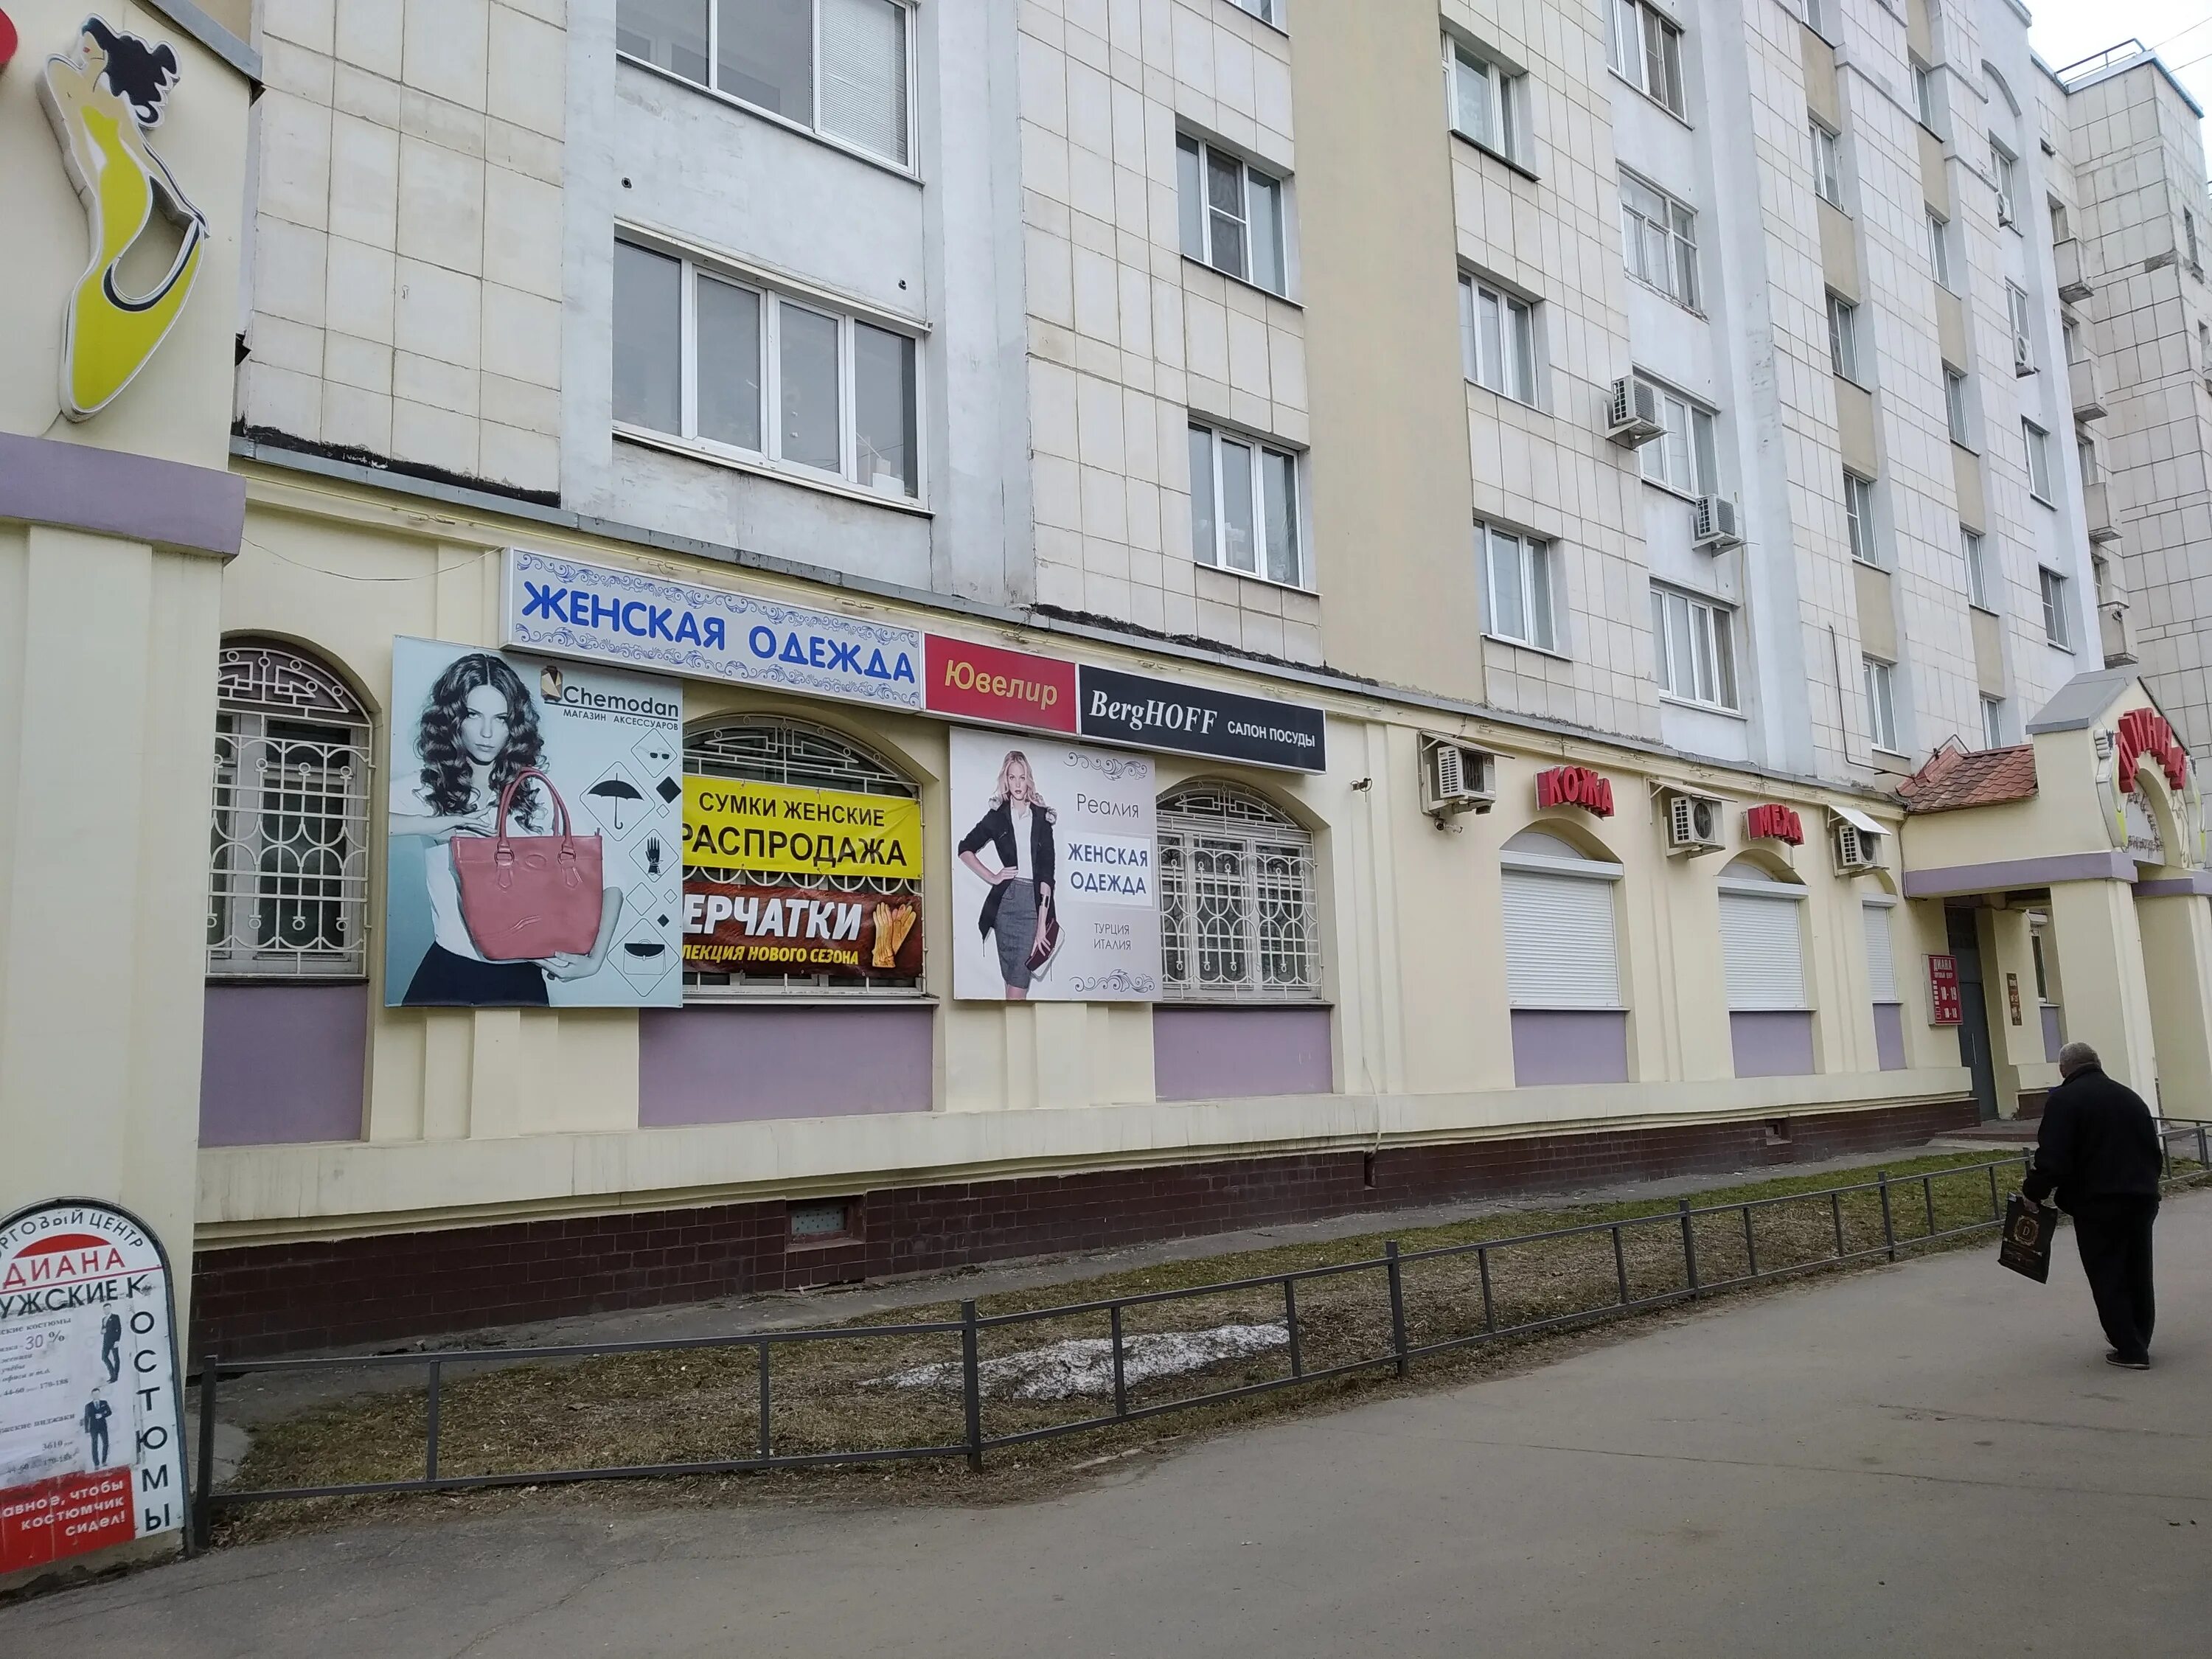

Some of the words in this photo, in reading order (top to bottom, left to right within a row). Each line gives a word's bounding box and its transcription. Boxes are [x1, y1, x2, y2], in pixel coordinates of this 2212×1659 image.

[521, 580, 725, 650] ЖЕНСКАЯ
[748, 625, 915, 684] ОДЕЖДА
[945, 659, 1058, 710] Ювелир
[563, 686, 678, 717] Chemodan
[1089, 689, 1218, 735] BergHOFF
[563, 709, 606, 721] МАГАЗИН
[613, 715, 678, 731] АКСЕССУАРОВ
[1227, 720, 1267, 740] САЛОН
[1268, 727, 1315, 748] ПОСУДЫ
[1077, 793, 1139, 818] Реалия
[1541, 765, 1615, 817] КОЖА
[699, 792, 776, 818] СУМКИ
[783, 800, 885, 827] ЖЕНСКИЕ
[1755, 803, 1805, 846] МЕХА
[1068, 843, 1148, 867] ЖЕНСКАЯ
[1071, 871, 1147, 895] ОДЕЖДА
[1094, 922, 1130, 936] ТУРЦИЯ
[747, 946, 807, 963] НОВОГО
[810, 948, 859, 965] СЕЗОНА
[1093, 939, 1131, 950] ИТАЛИЯ
[0, 1209, 83, 1253] РГОВЫЙ
[88, 1213, 144, 1251] ЦЕНТР
[3, 1247, 125, 1290] ДИАНА
[0, 1326, 24, 1336] ские
[27, 1318, 72, 1330] костюмы
[48, 1330, 65, 1342] %
[0, 1495, 66, 1517] авное,
[70, 1480, 124, 1500] чтобы
[21, 1496, 125, 1531] костюмчик
[65, 1510, 125, 1537] сидел!
